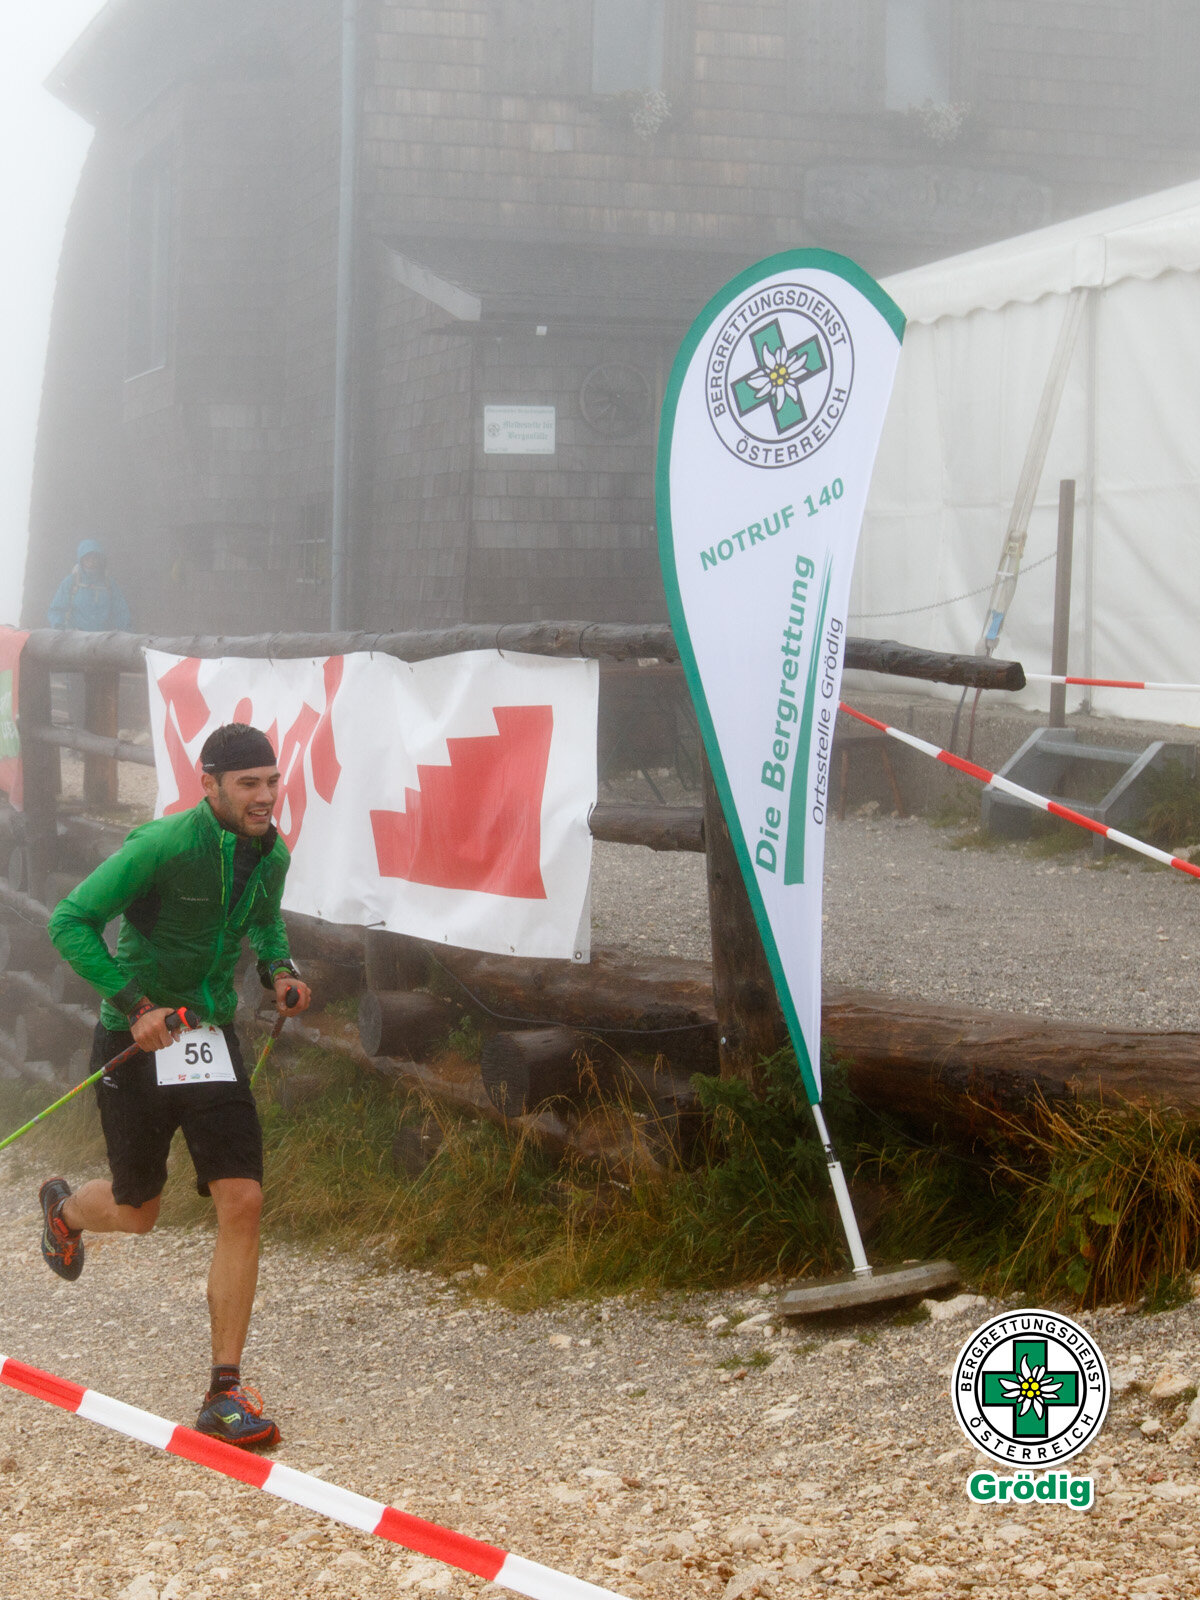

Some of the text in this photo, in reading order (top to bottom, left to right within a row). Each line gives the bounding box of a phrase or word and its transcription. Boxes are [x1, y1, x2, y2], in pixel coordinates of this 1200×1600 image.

[711, 290, 846, 417] BERGRETTUNGSDIENST
[736, 387, 847, 463] ÖSTERREICH
[699, 477, 844, 571] NOTRUF 140
[756, 554, 815, 874] Die Bergrettung
[813, 617, 844, 825] Ortsstelle Grödig
[185, 1042, 213, 1065] 56
